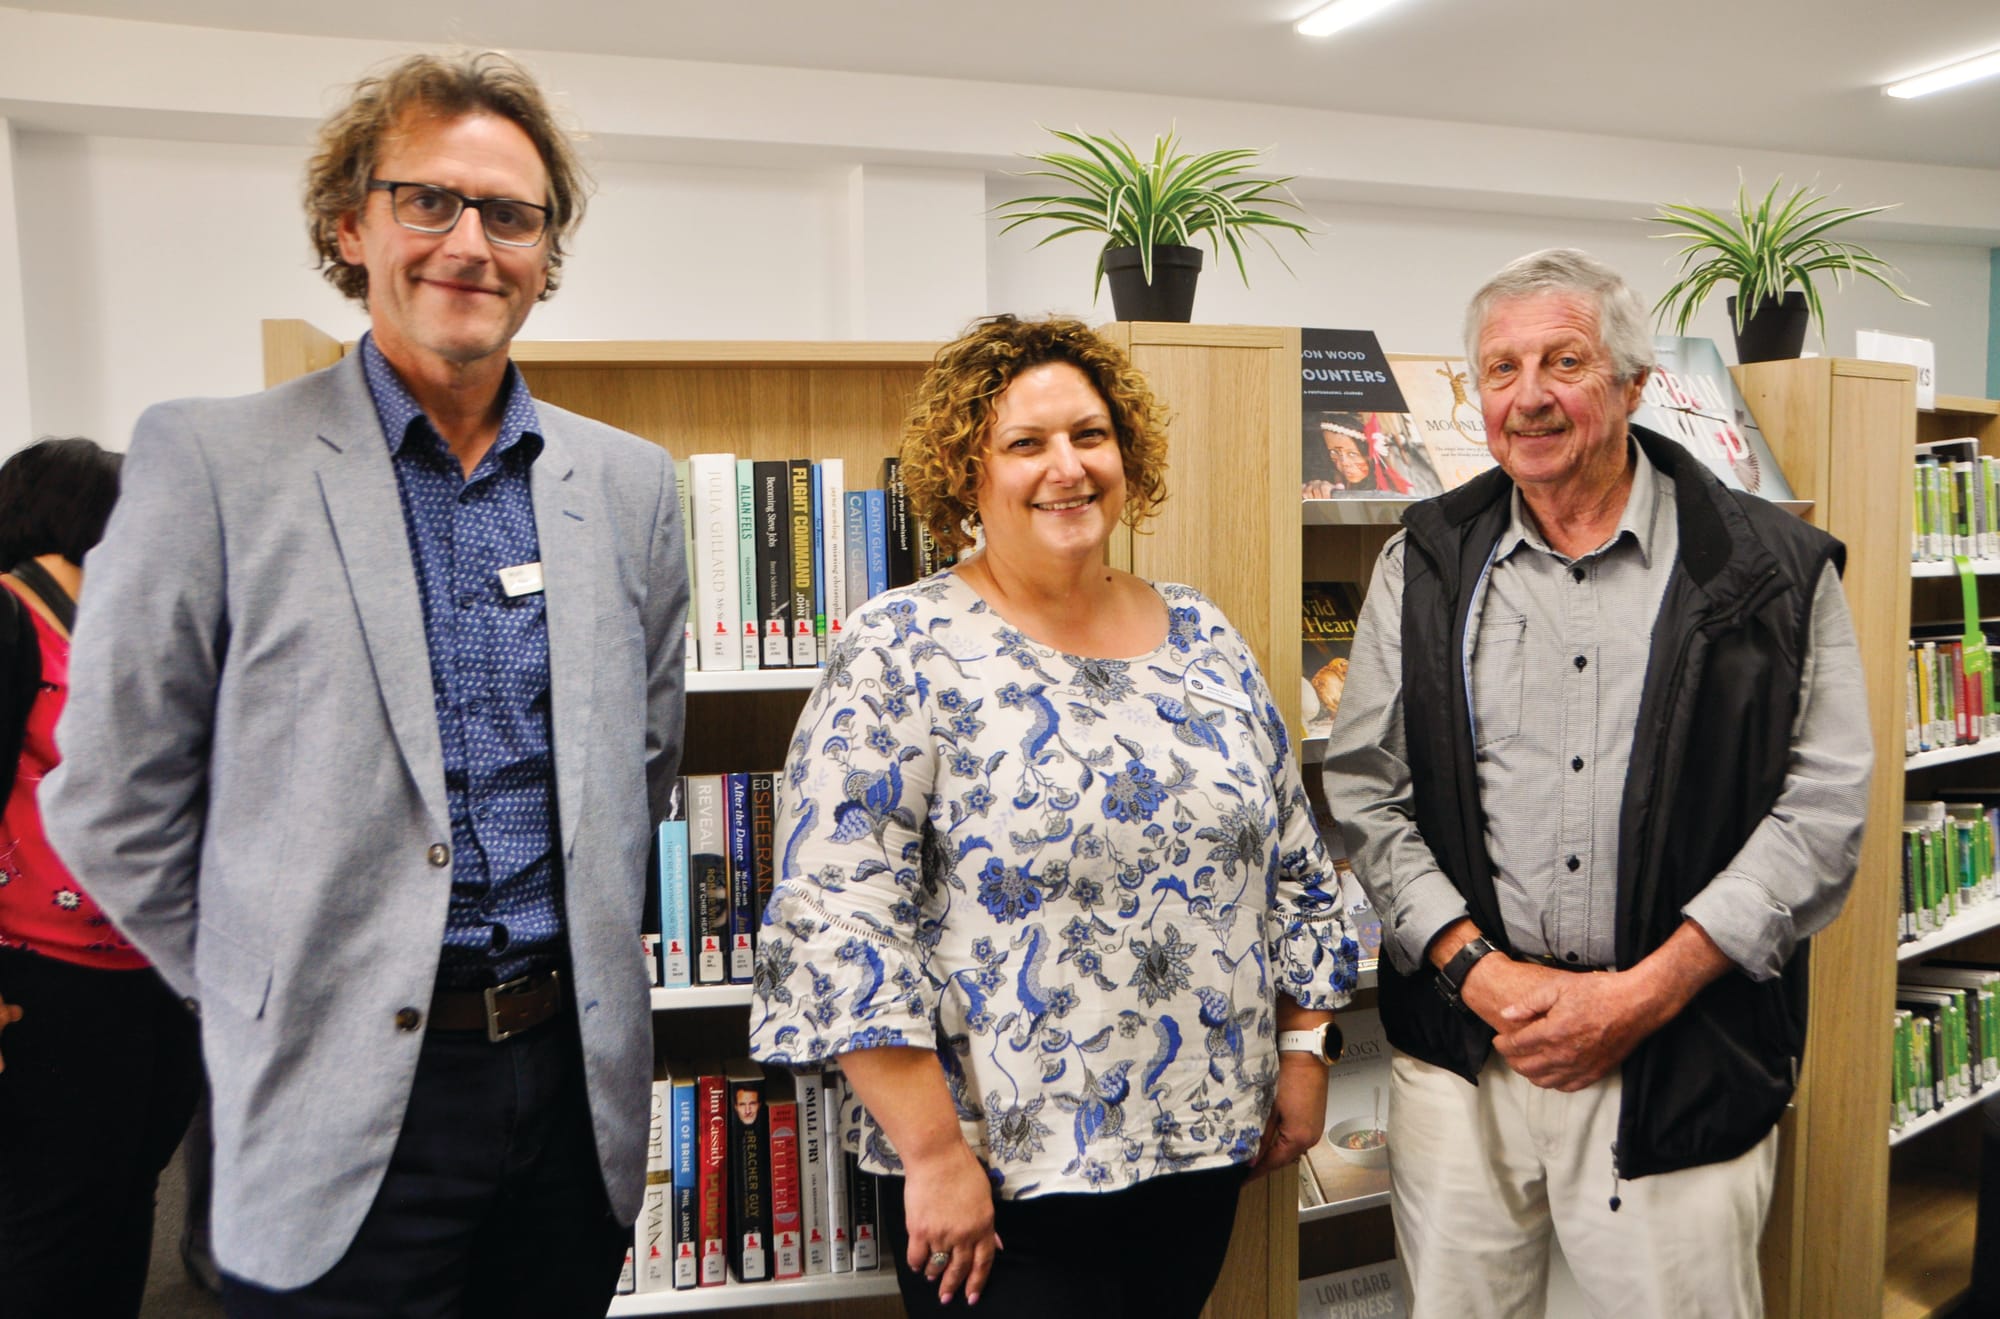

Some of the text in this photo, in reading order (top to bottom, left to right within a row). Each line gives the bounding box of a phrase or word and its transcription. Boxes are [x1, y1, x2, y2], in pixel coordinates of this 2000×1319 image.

[1325, 350, 1366, 360] WOOD
[1302, 368, 1386, 383] OUNTERS
[1644, 372, 1727, 408] URBAN
[740, 484, 753, 540] ALLAN FELS
[764, 476, 777, 548] Becoming Steve Jobs
[850, 495, 863, 546] CATHY
[871, 497, 881, 535] CATHY
[897, 499, 905, 512] you
[707, 471, 726, 593] JULIA GILLARD
[792, 467, 810, 588] FLIGHT COMMAND
[831, 543, 840, 574] missing
[872, 537, 883, 572] GLASS
[924, 552, 932, 561] OF
[796, 591, 806, 616] JOHN
[752, 779, 771, 790] ED
[698, 784, 713, 851] REVEAL
[734, 781, 748, 861] After the Dance
[753, 791, 773, 893] SHEERAN
[699, 882, 707, 892] BY
[699, 893, 708, 916] CHRIS
[668, 907, 676, 924] OUR
[680, 1101, 691, 1174] LIFE OF BRINE
[706, 1086, 724, 1168] Jim Cassidy
[805, 1087, 819, 1164] SMALL FRY
[747, 1135, 760, 1190] REACHER
[773, 1139, 788, 1211] FULLER
[681, 1188, 690, 1207] PHIL
[749, 1193, 760, 1217] GUY
[1315, 1272, 1391, 1305] LOW CARB
[1329, 1293, 1394, 1319] EXPRESS
